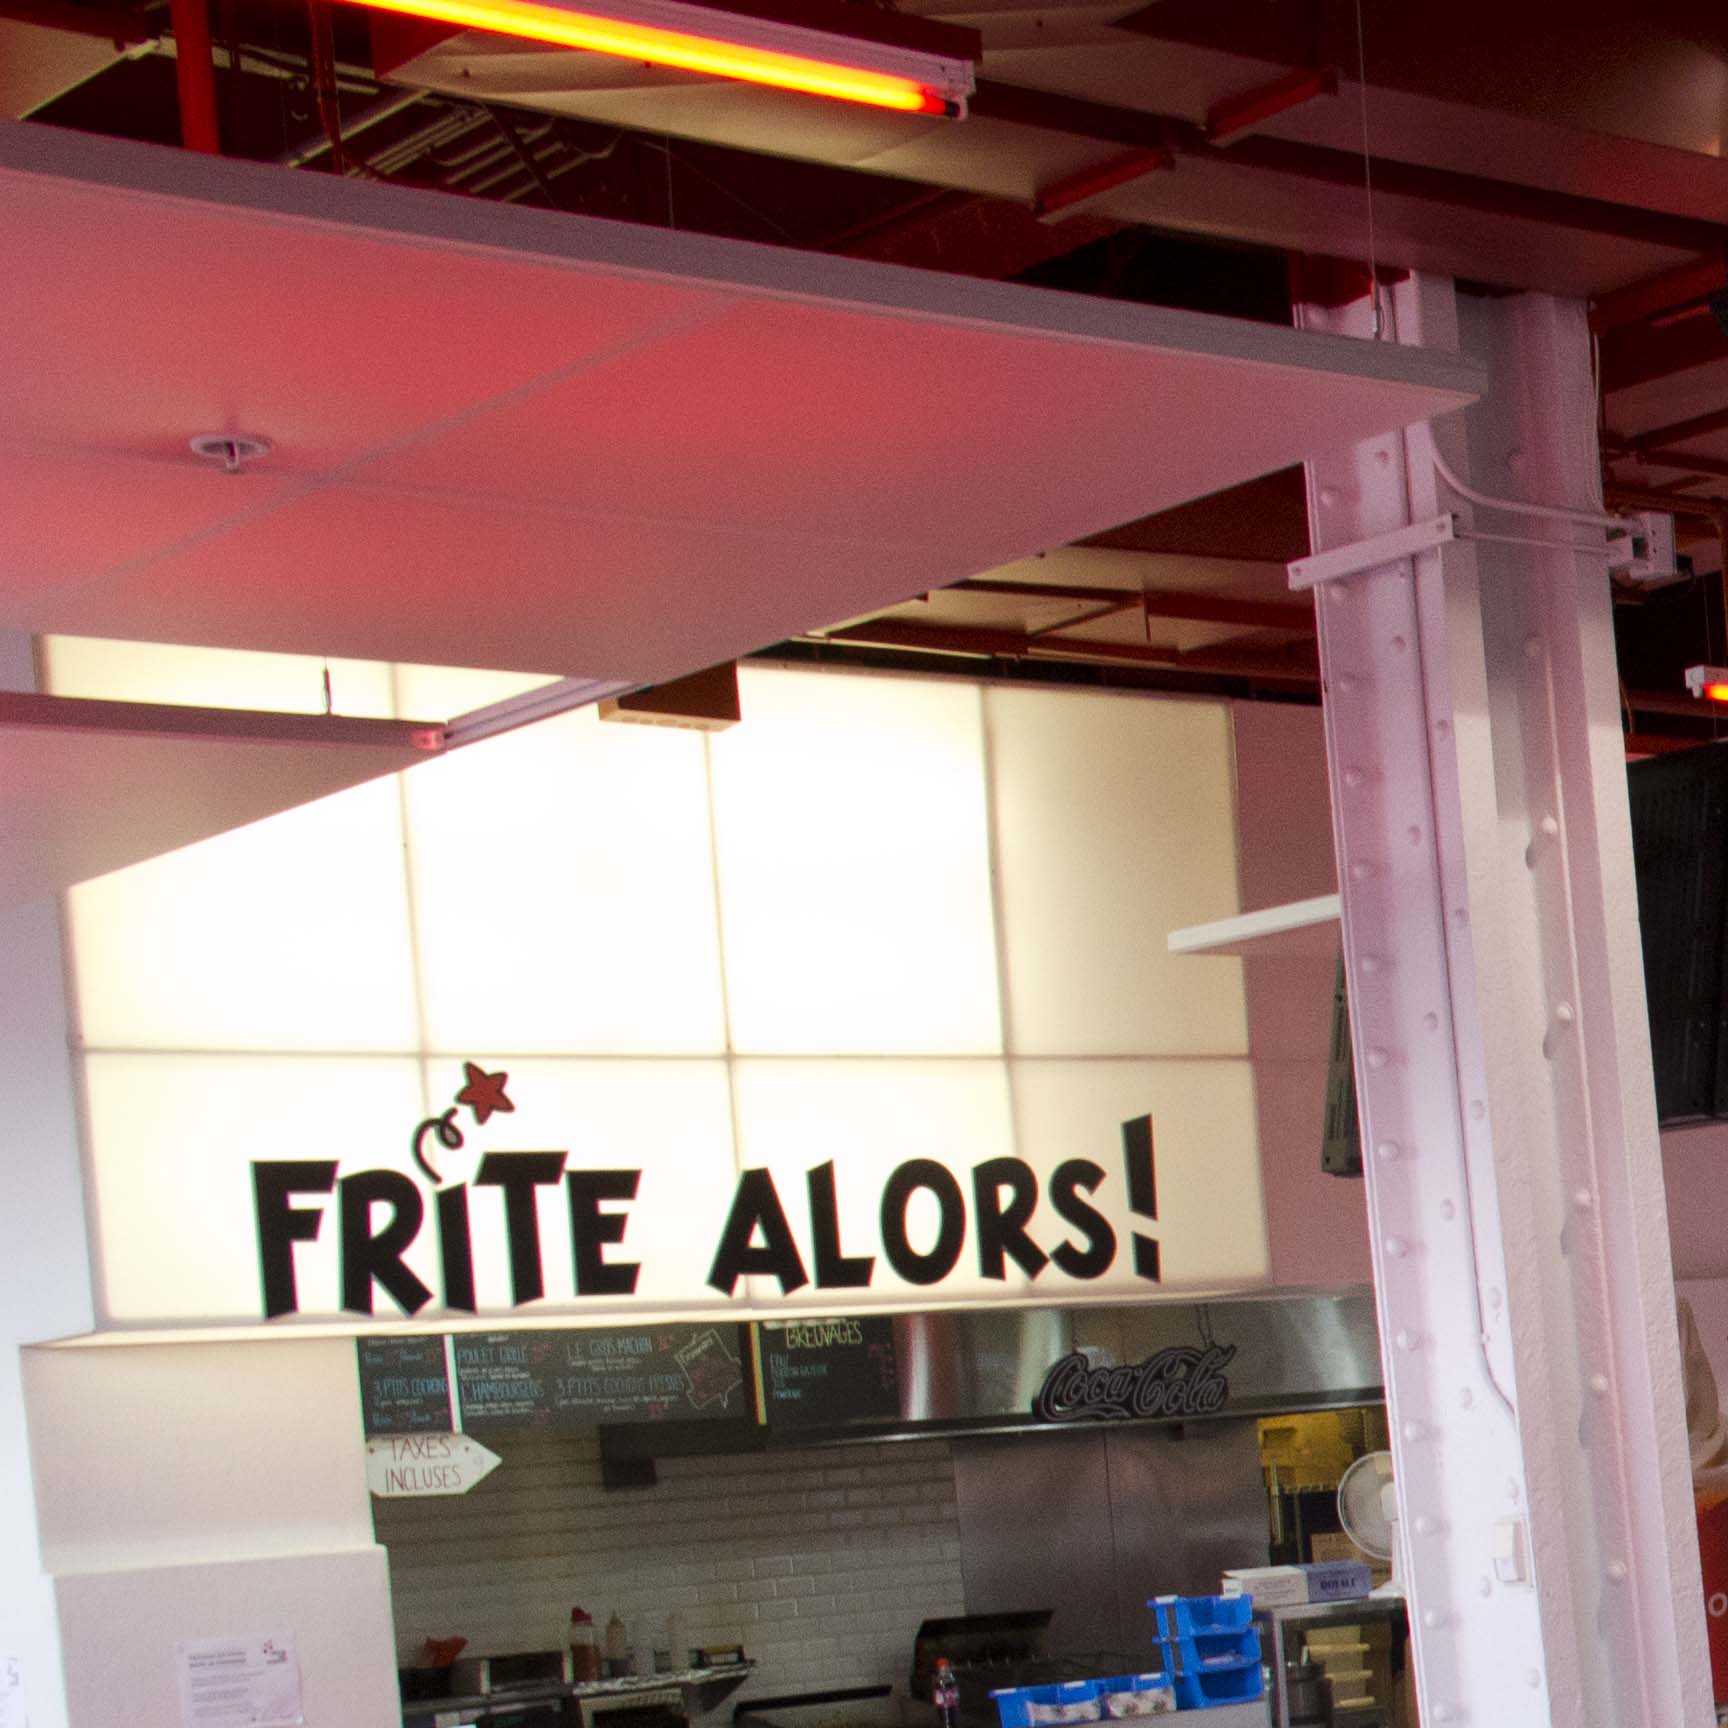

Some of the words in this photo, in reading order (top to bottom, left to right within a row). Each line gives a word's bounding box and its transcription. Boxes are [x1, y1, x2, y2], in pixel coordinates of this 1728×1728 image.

[250, 1151, 643, 1320] FRITE
[705, 1112, 1162, 1298] ALORS!
[1040, 1342, 1237, 1422] Coca-Cola
[391, 1436, 451, 1462] TAXES
[385, 1464, 462, 1494] INCLUSES
